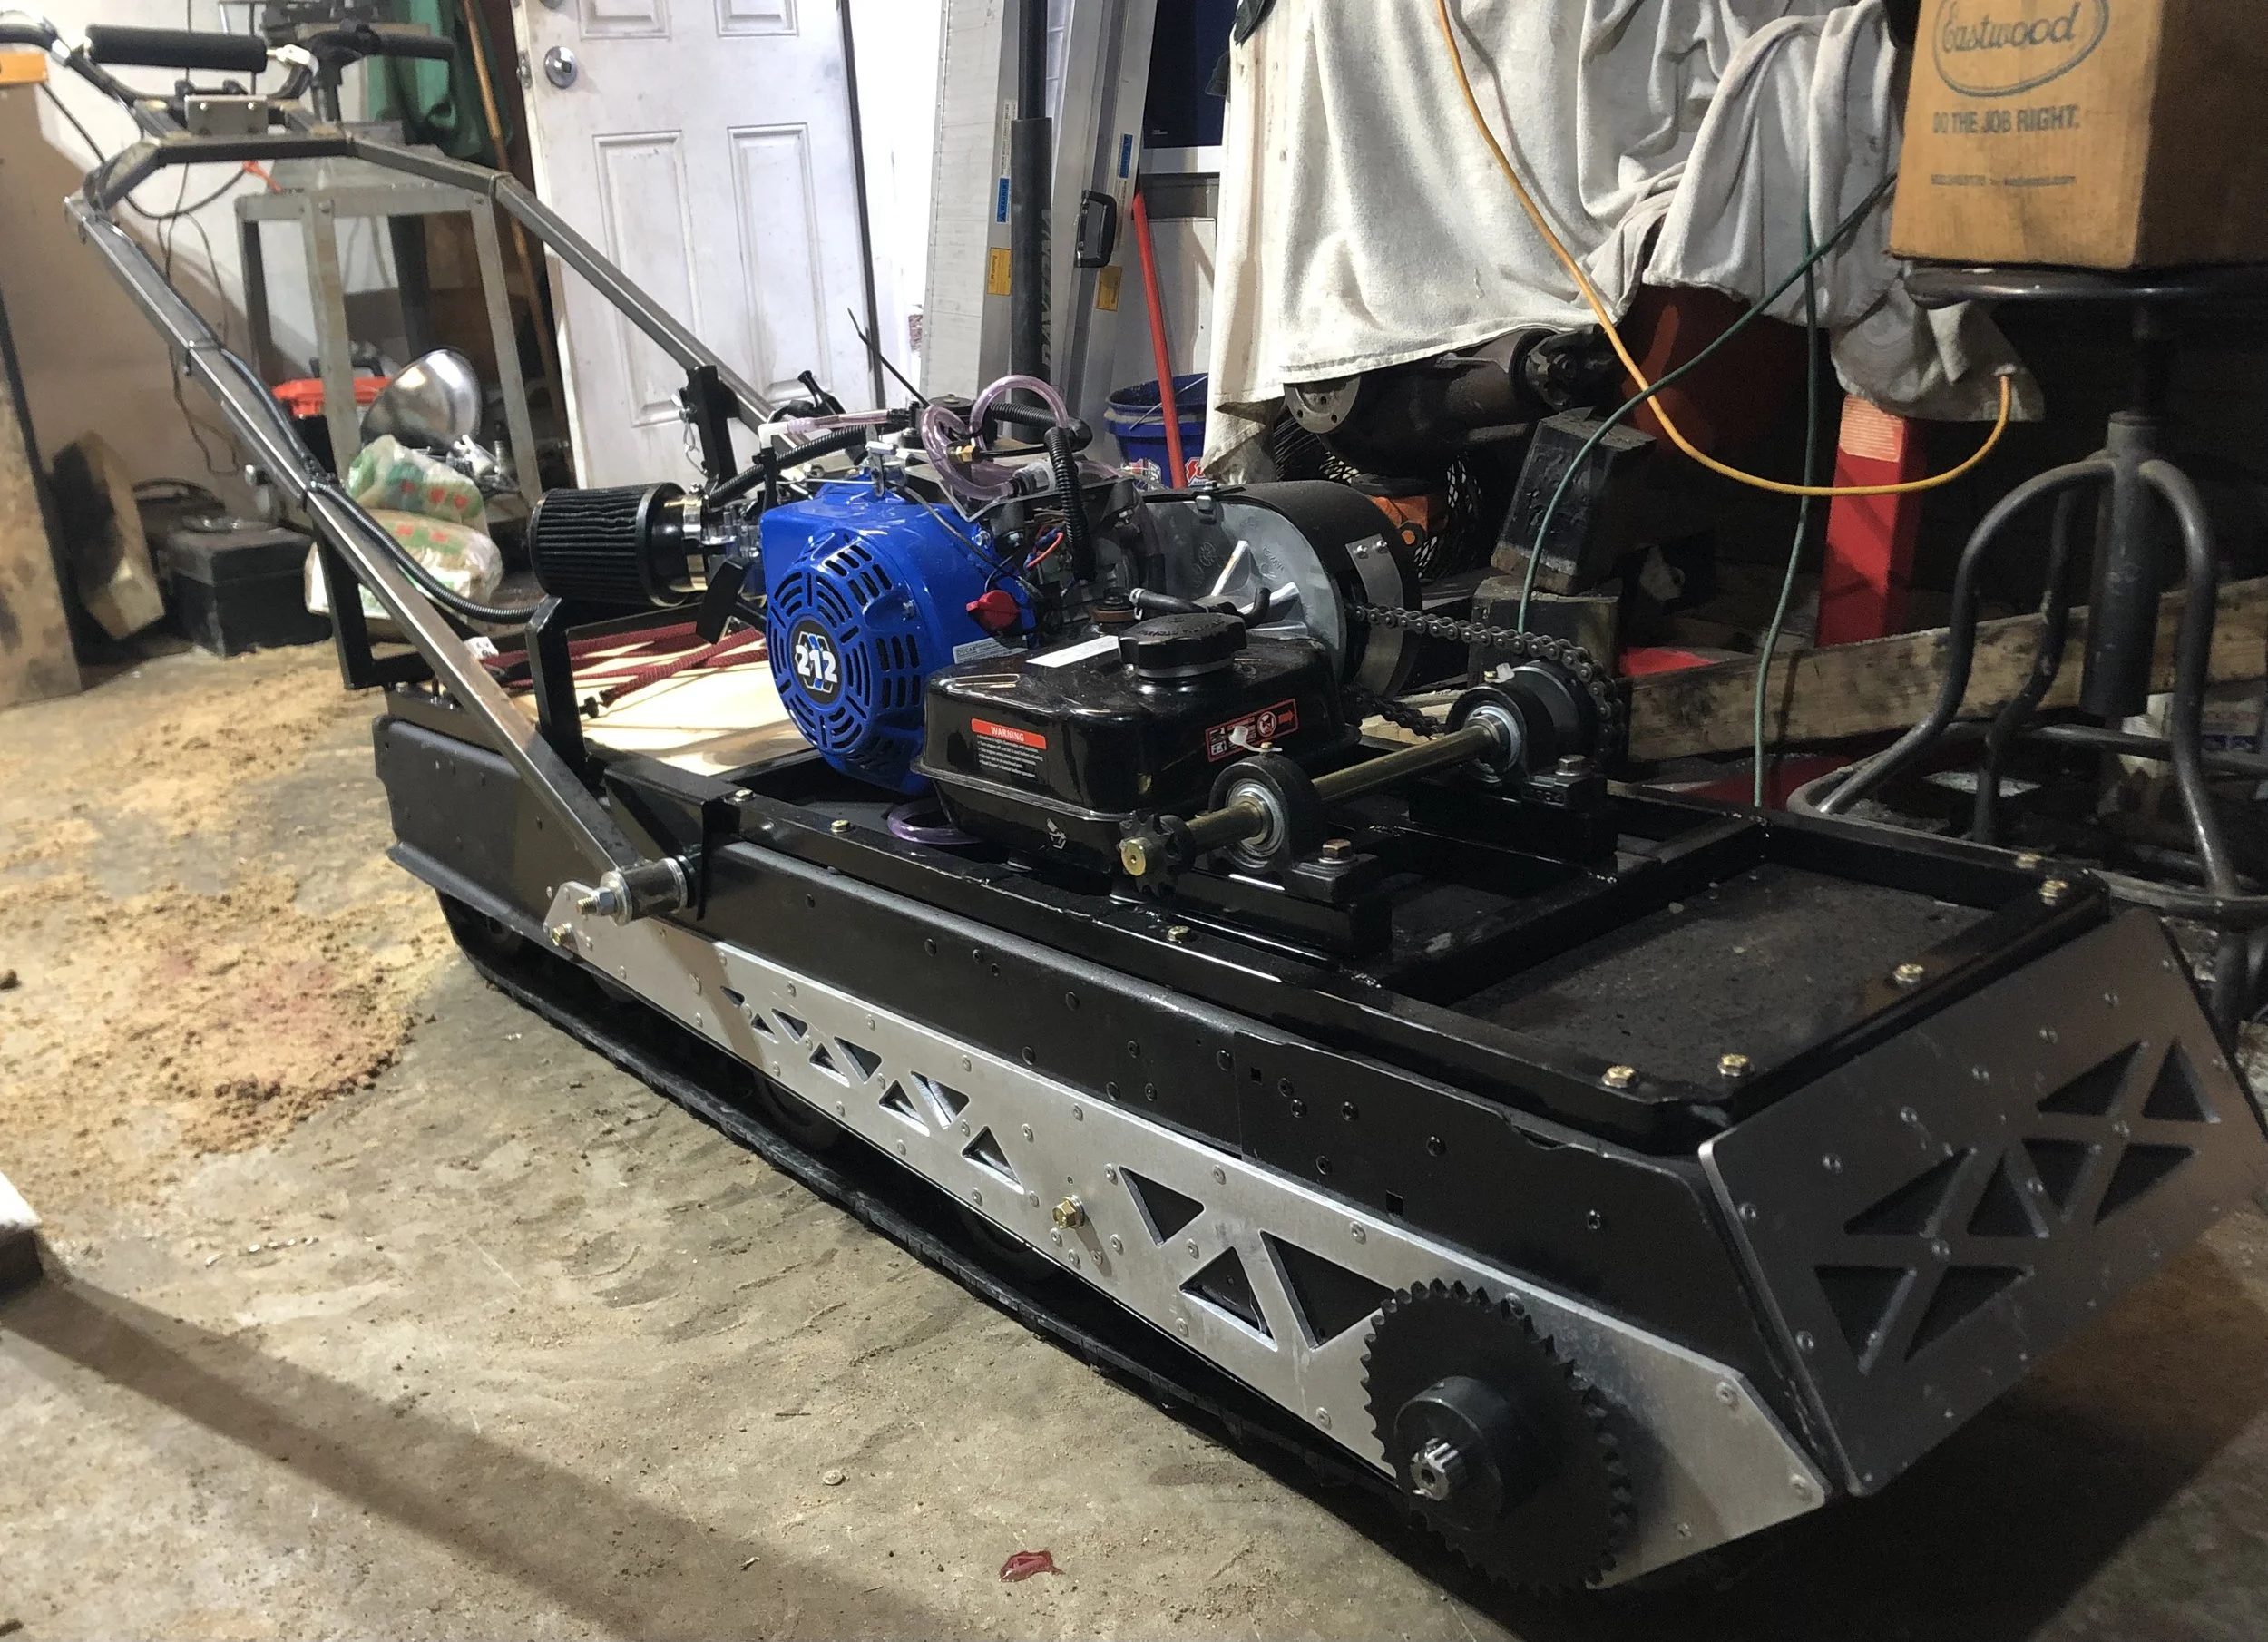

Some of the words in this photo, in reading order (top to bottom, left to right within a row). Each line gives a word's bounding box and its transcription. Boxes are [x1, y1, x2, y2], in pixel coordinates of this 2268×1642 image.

[1943, 1, 2081, 53] Eastwood
[1951, 111, 1978, 133] THE
[1981, 109, 2011, 133] JOB
[2017, 104, 2080, 132] RIGHT.
[796, 644, 837, 683] 212
[991, 726, 1024, 742] WARNING
